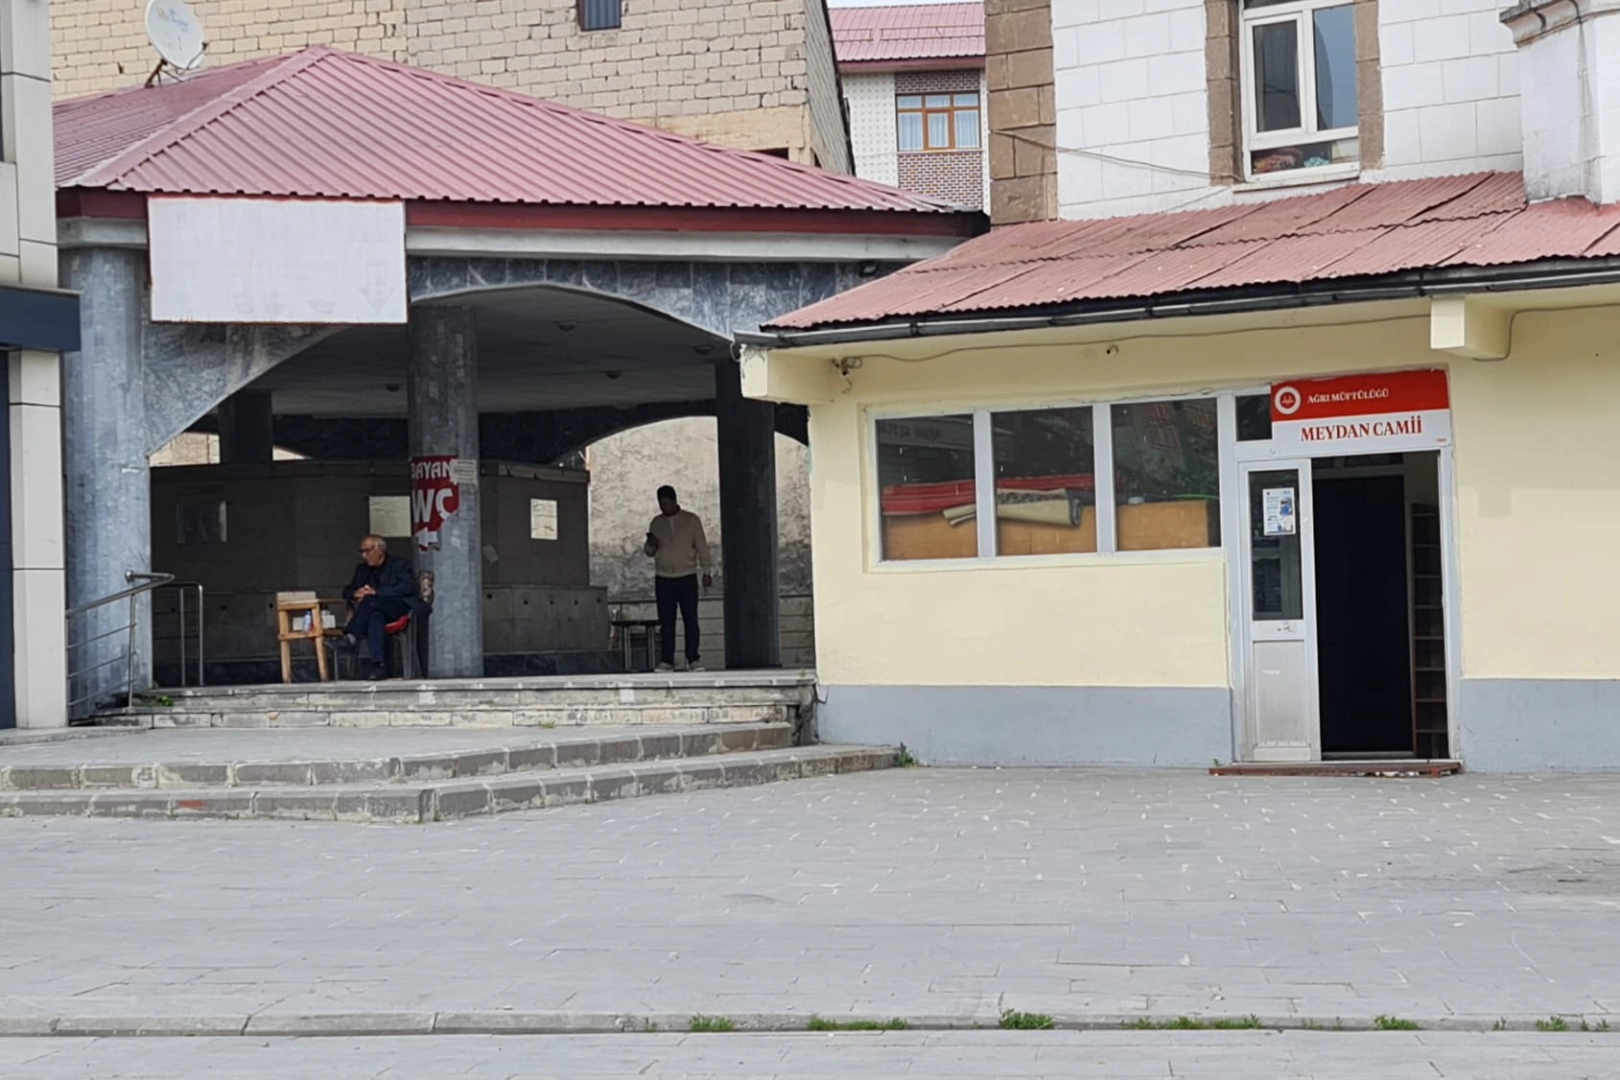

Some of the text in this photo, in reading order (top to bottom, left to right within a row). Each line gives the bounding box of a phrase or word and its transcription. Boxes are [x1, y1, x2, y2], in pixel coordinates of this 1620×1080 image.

[1307, 388, 1389, 404] AĞRI MÜFTÜLÜĞÜ
[1300, 416, 1422, 441] MEYDAN CAMİİ
[411, 488, 453, 523] WC
